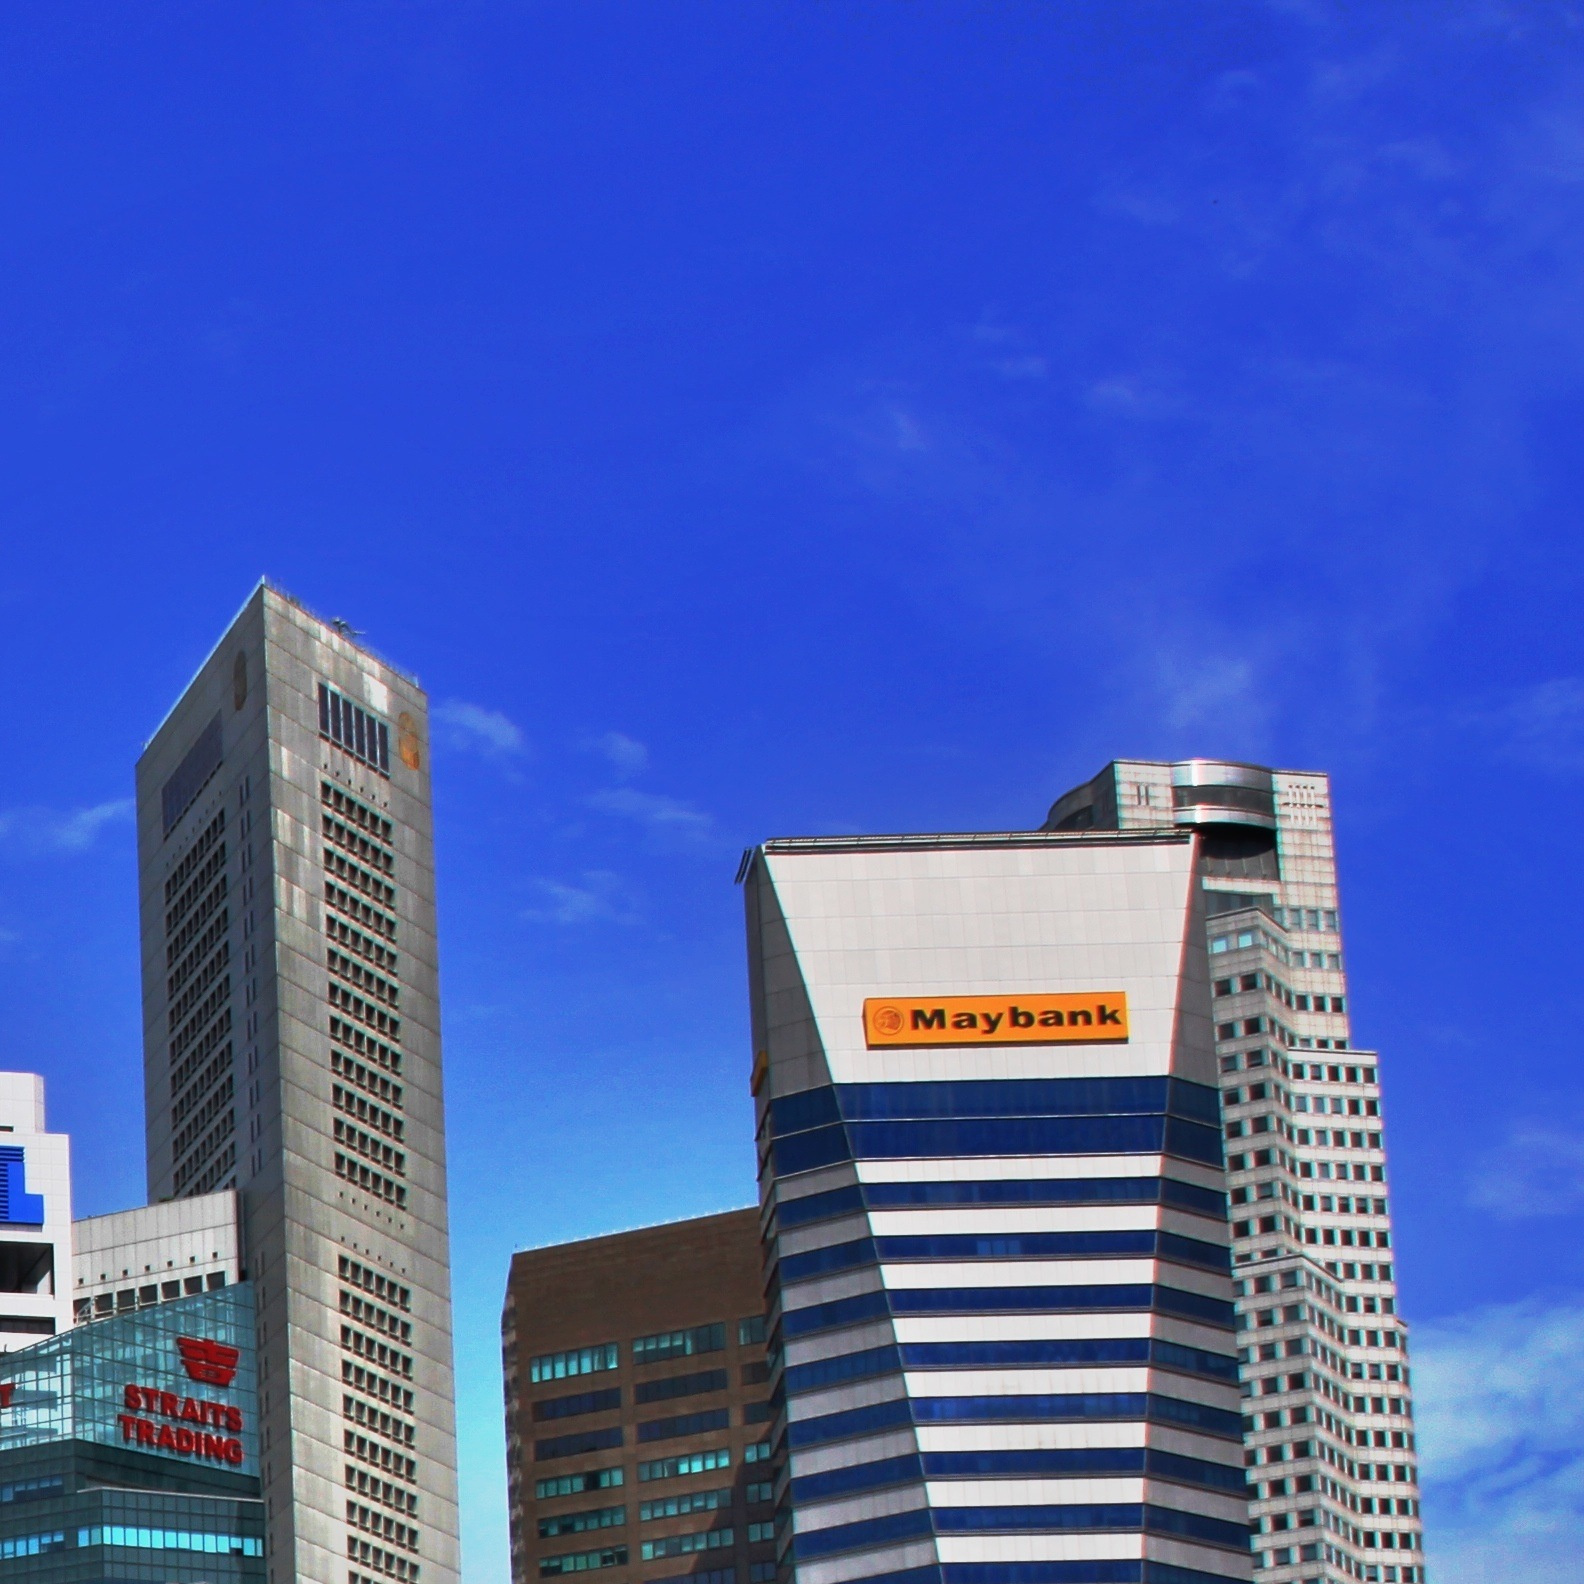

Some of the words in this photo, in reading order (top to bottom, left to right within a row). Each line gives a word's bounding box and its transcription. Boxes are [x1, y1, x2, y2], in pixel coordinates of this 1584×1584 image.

[910, 1004, 1122, 1035] Maybank
[123, 1383, 243, 1433] STRAITS
[117, 1413, 244, 1465] TRADING
